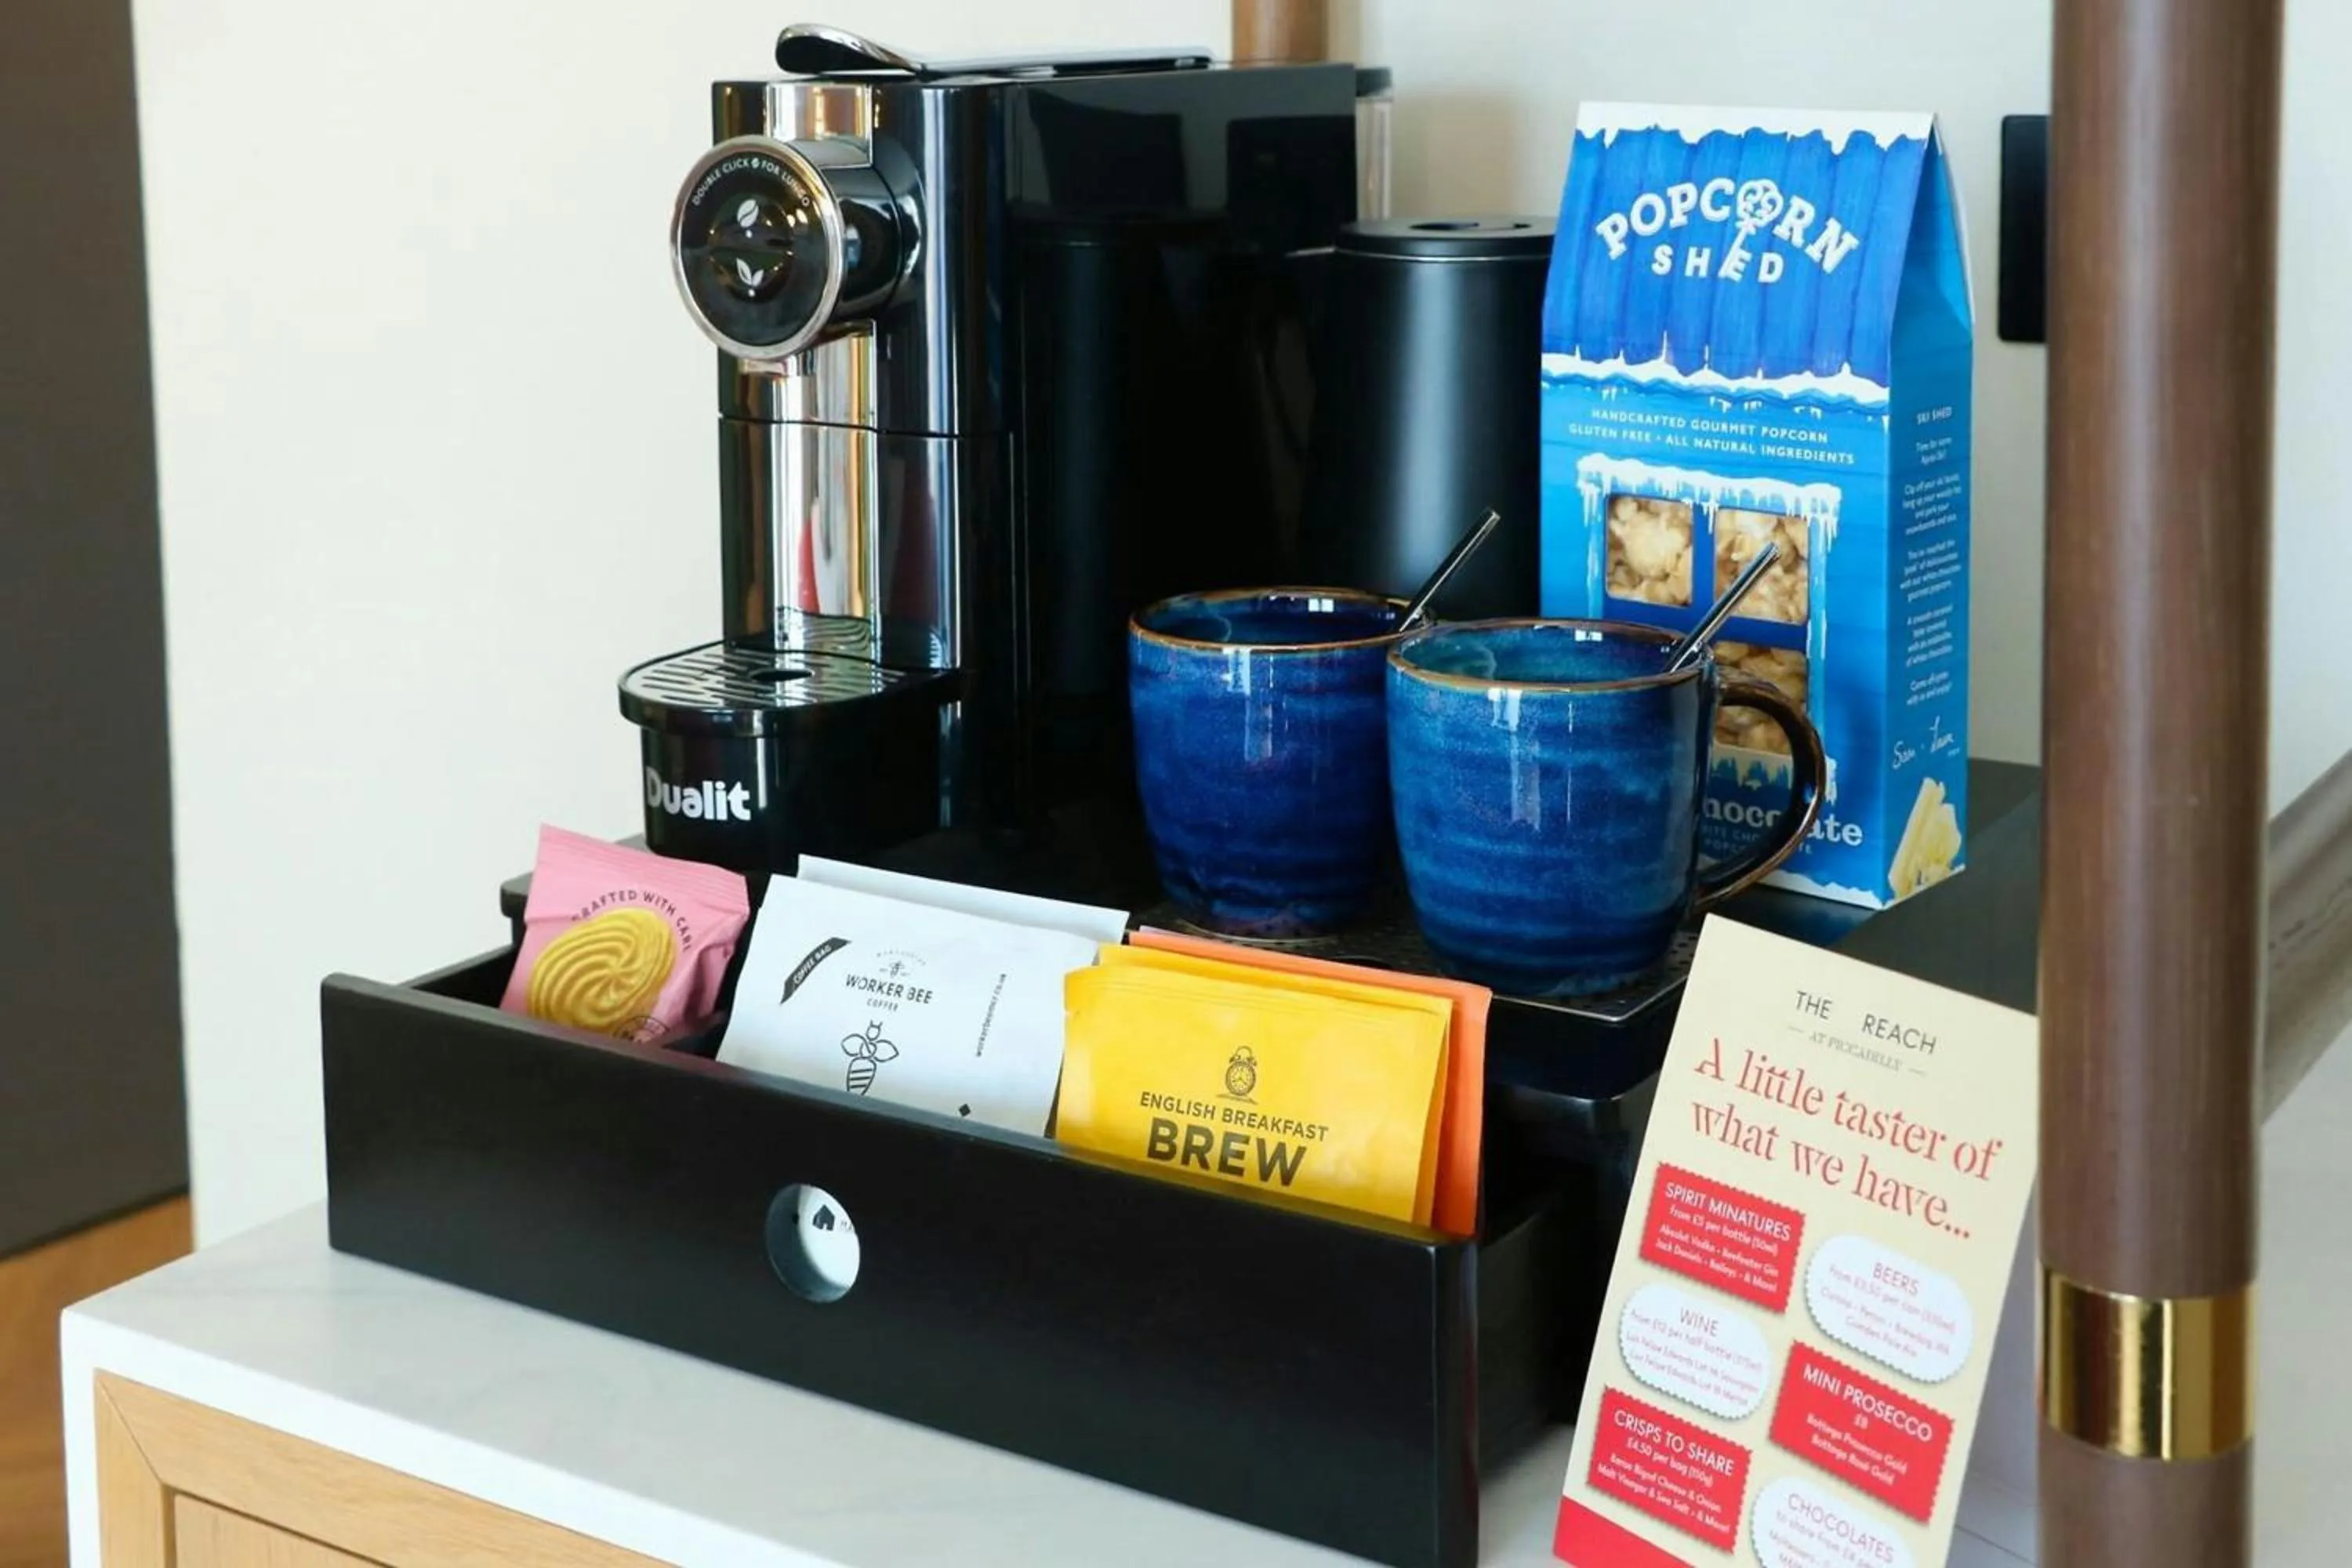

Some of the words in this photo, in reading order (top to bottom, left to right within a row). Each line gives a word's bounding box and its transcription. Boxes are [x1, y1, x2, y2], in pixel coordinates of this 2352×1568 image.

[691, 168, 721, 206] DOUBLE
[722, 158, 750, 173] CLICK
[761, 160, 780, 176] FOR
[782, 172, 811, 208] LUO
[1595, 177, 1859, 274] POPCORN
[1652, 244, 1785, 283] SHED
[1569, 423, 1619, 440] GLUTEN
[1622, 428, 1652, 443] FREE
[1665, 433, 1689, 447] ALL
[1693, 437, 1756, 455] NATURAL
[1762, 445, 1855, 466] INGREDIENTS
[1592, 409, 1686, 429] HANDCRAFTED
[1691, 418, 1756, 436] GOURMET
[1762, 426, 1828, 444] POPCORN
[645, 765, 752, 821] Dualit
[643, 891, 677, 916] WITH
[845, 973, 904, 998] WORKER
[906, 985, 934, 1004] BEE
[866, 997, 898, 1012] COFFEE
[1796, 990, 1833, 1021] THE
[1861, 1014, 1938, 1055] REACH
[1140, 1091, 1217, 1120] ENGLISH
[1221, 1107, 1329, 1142] BREAKFAST
[1694, 1037, 1724, 1082] A
[1735, 1050, 1824, 1117] little
[1834, 1091, 1947, 1162] taster
[1953, 1138, 2004, 1181] of
[1146, 1117, 1307, 1187] BREW
[1693, 1101, 1780, 1162] what
[1791, 1140, 1845, 1185] we
[1852, 1154, 1971, 1240] have...
[1664, 1182, 1707, 1208] SPIRIT
[1708, 1197, 1792, 1241] MINATURES
[1872, 1261, 1920, 1296] BEERS
[1679, 1307, 1719, 1337] WINE
[1803, 1364, 1841, 1396] MINI
[1843, 1384, 1933, 1443] PROSECCO
[1613, 1409, 1662, 1444] CRISPS
[1665, 1432, 1685, 1453] TO
[1687, 1442, 1735, 1477] SHARE
[1788, 1493, 1895, 1564] CHOCOLATES
